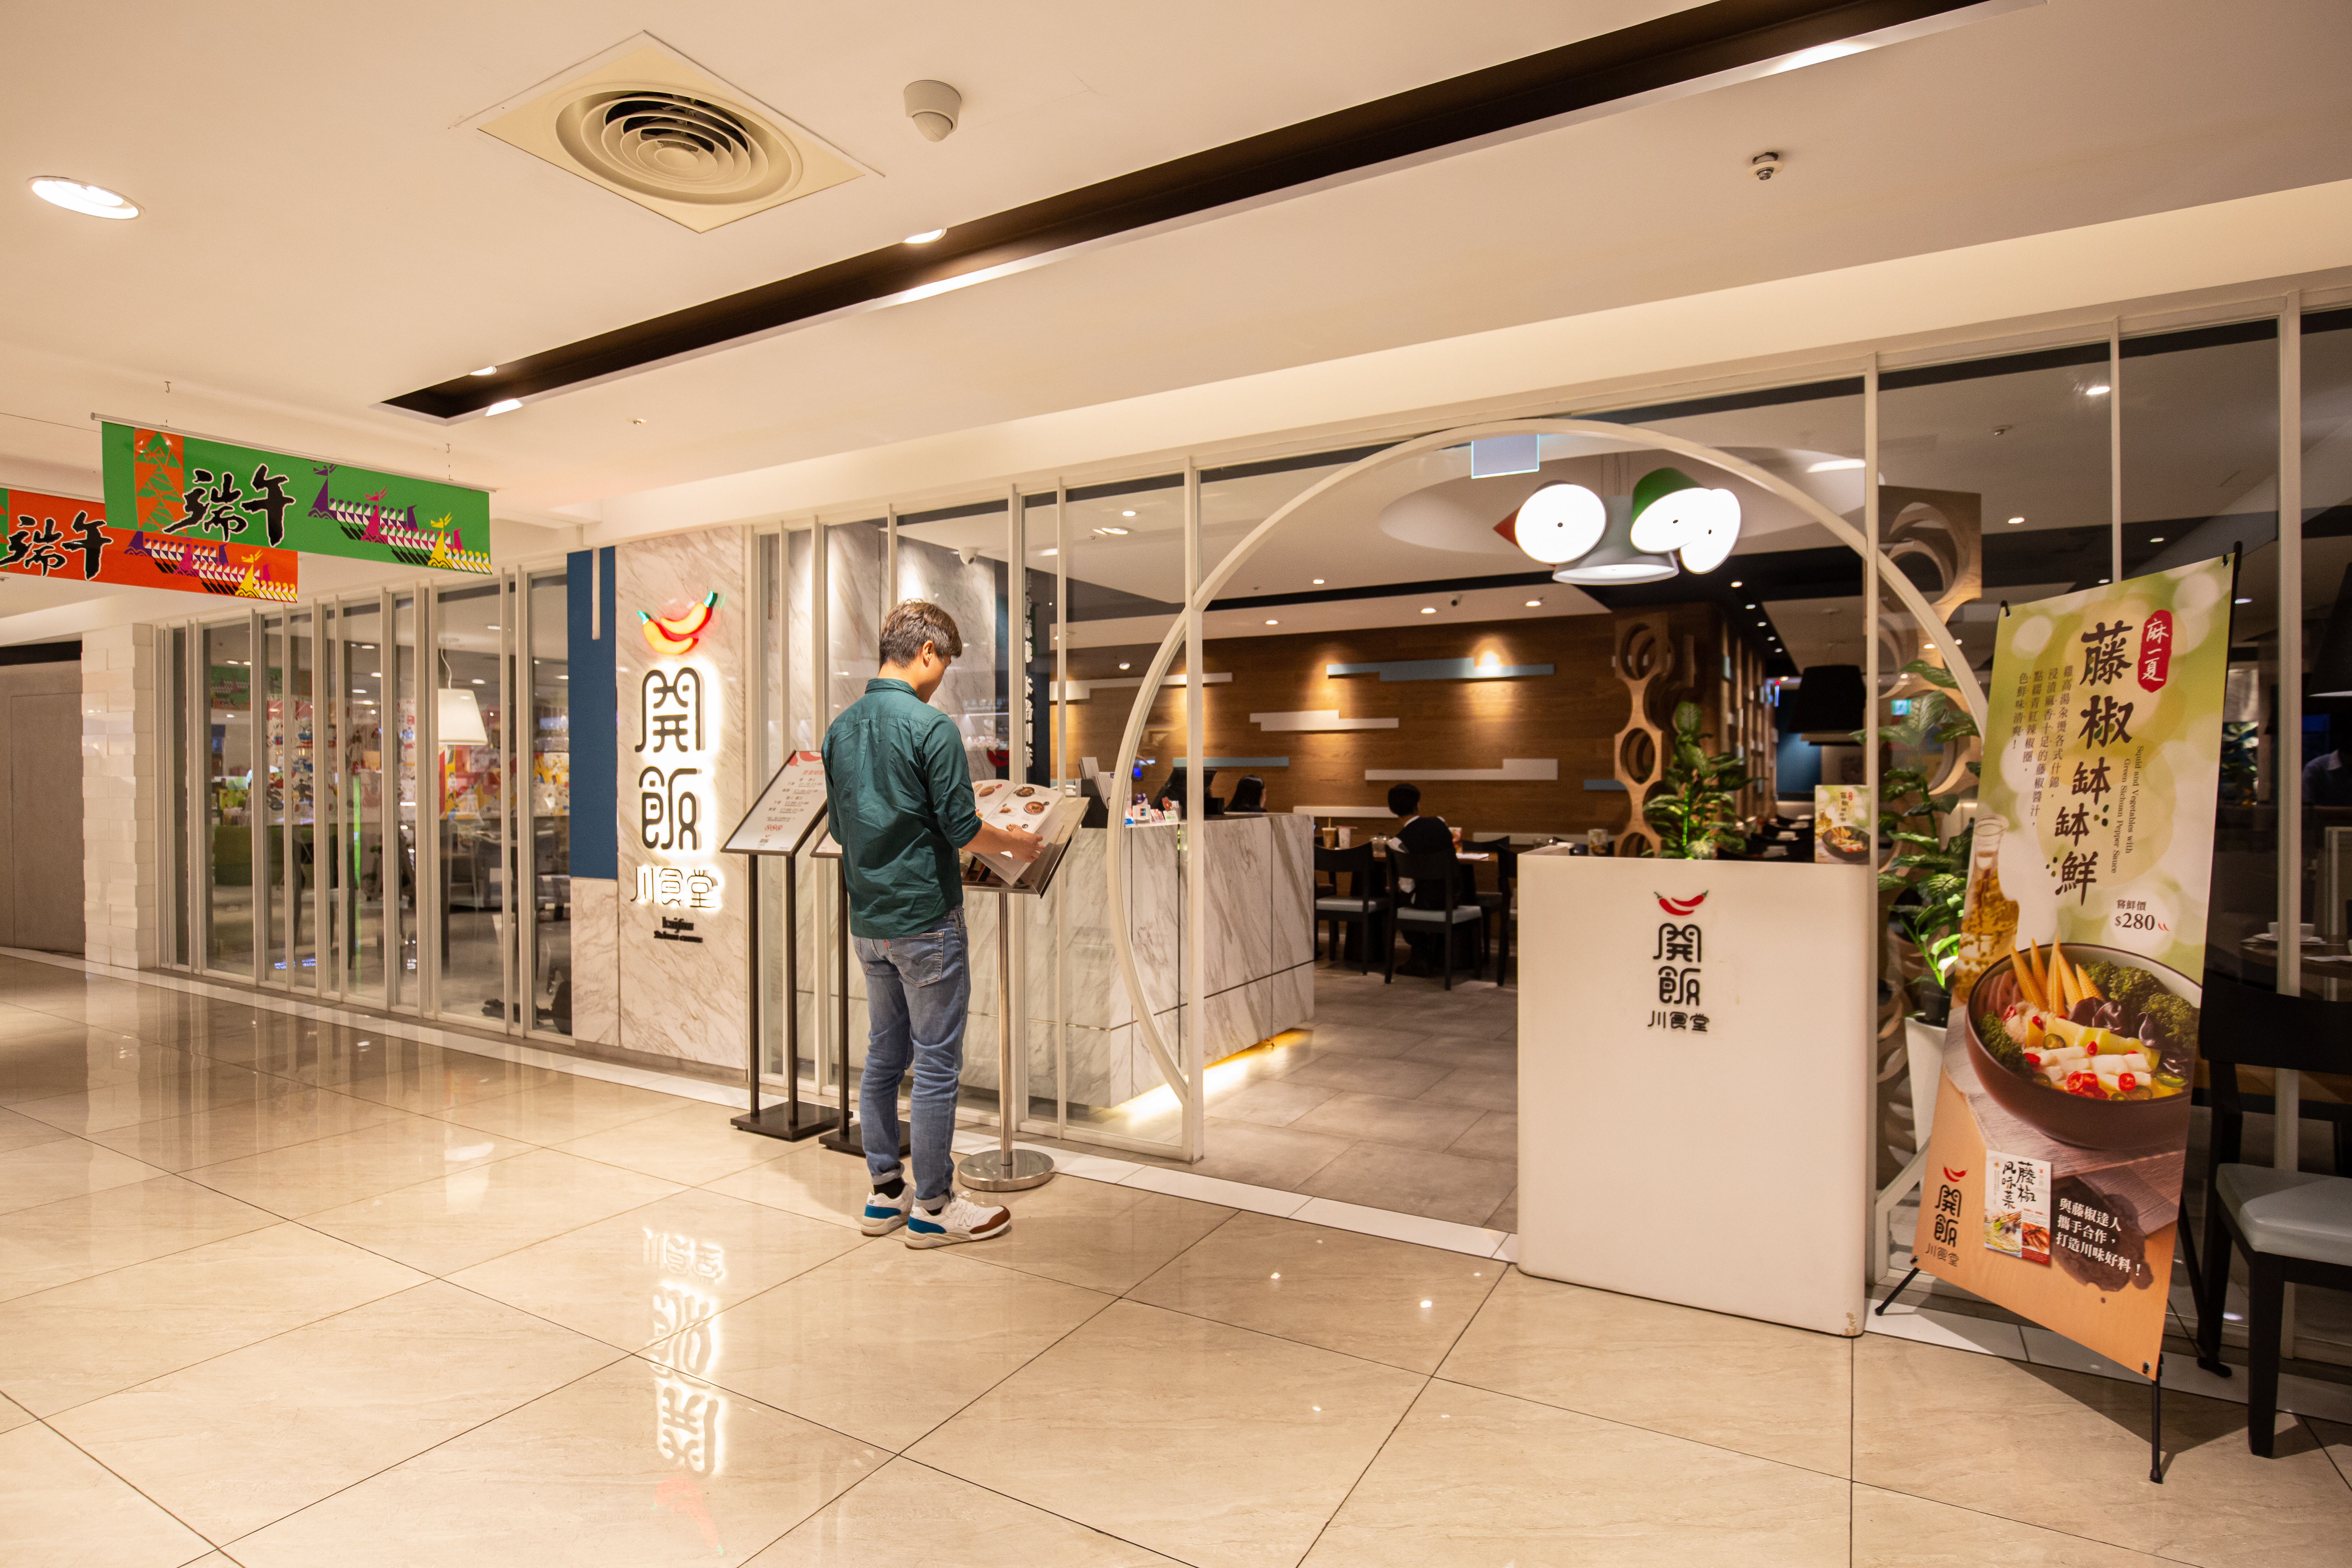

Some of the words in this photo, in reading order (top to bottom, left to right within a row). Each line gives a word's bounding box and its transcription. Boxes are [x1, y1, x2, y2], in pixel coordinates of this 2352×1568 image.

[163, 463, 296, 548] 端午
[0, 510, 113, 581] 端午
[2141, 618, 2169, 682] 麻一夏
[635, 667, 702, 851] 開飯
[2122, 758, 2131, 782] Green
[2135, 746, 2143, 768] Squid
[2118, 785, 2127, 817] Sichuan
[2128, 789, 2139, 832] Vegetables
[2114, 821, 2123, 848] Pepper
[2125, 835, 2134, 853] with
[2111, 850, 2120, 873] Sauce
[630, 865, 718, 909] 川食堂
[2115, 913, 2155, 931] $280
[1653, 922, 1702, 1007] 開飯
[1647, 1010, 1710, 1033] 川食堂
[1934, 1184, 1962, 1248] 開飯
[2059, 1198, 2122, 1232] 與藤椒達人
